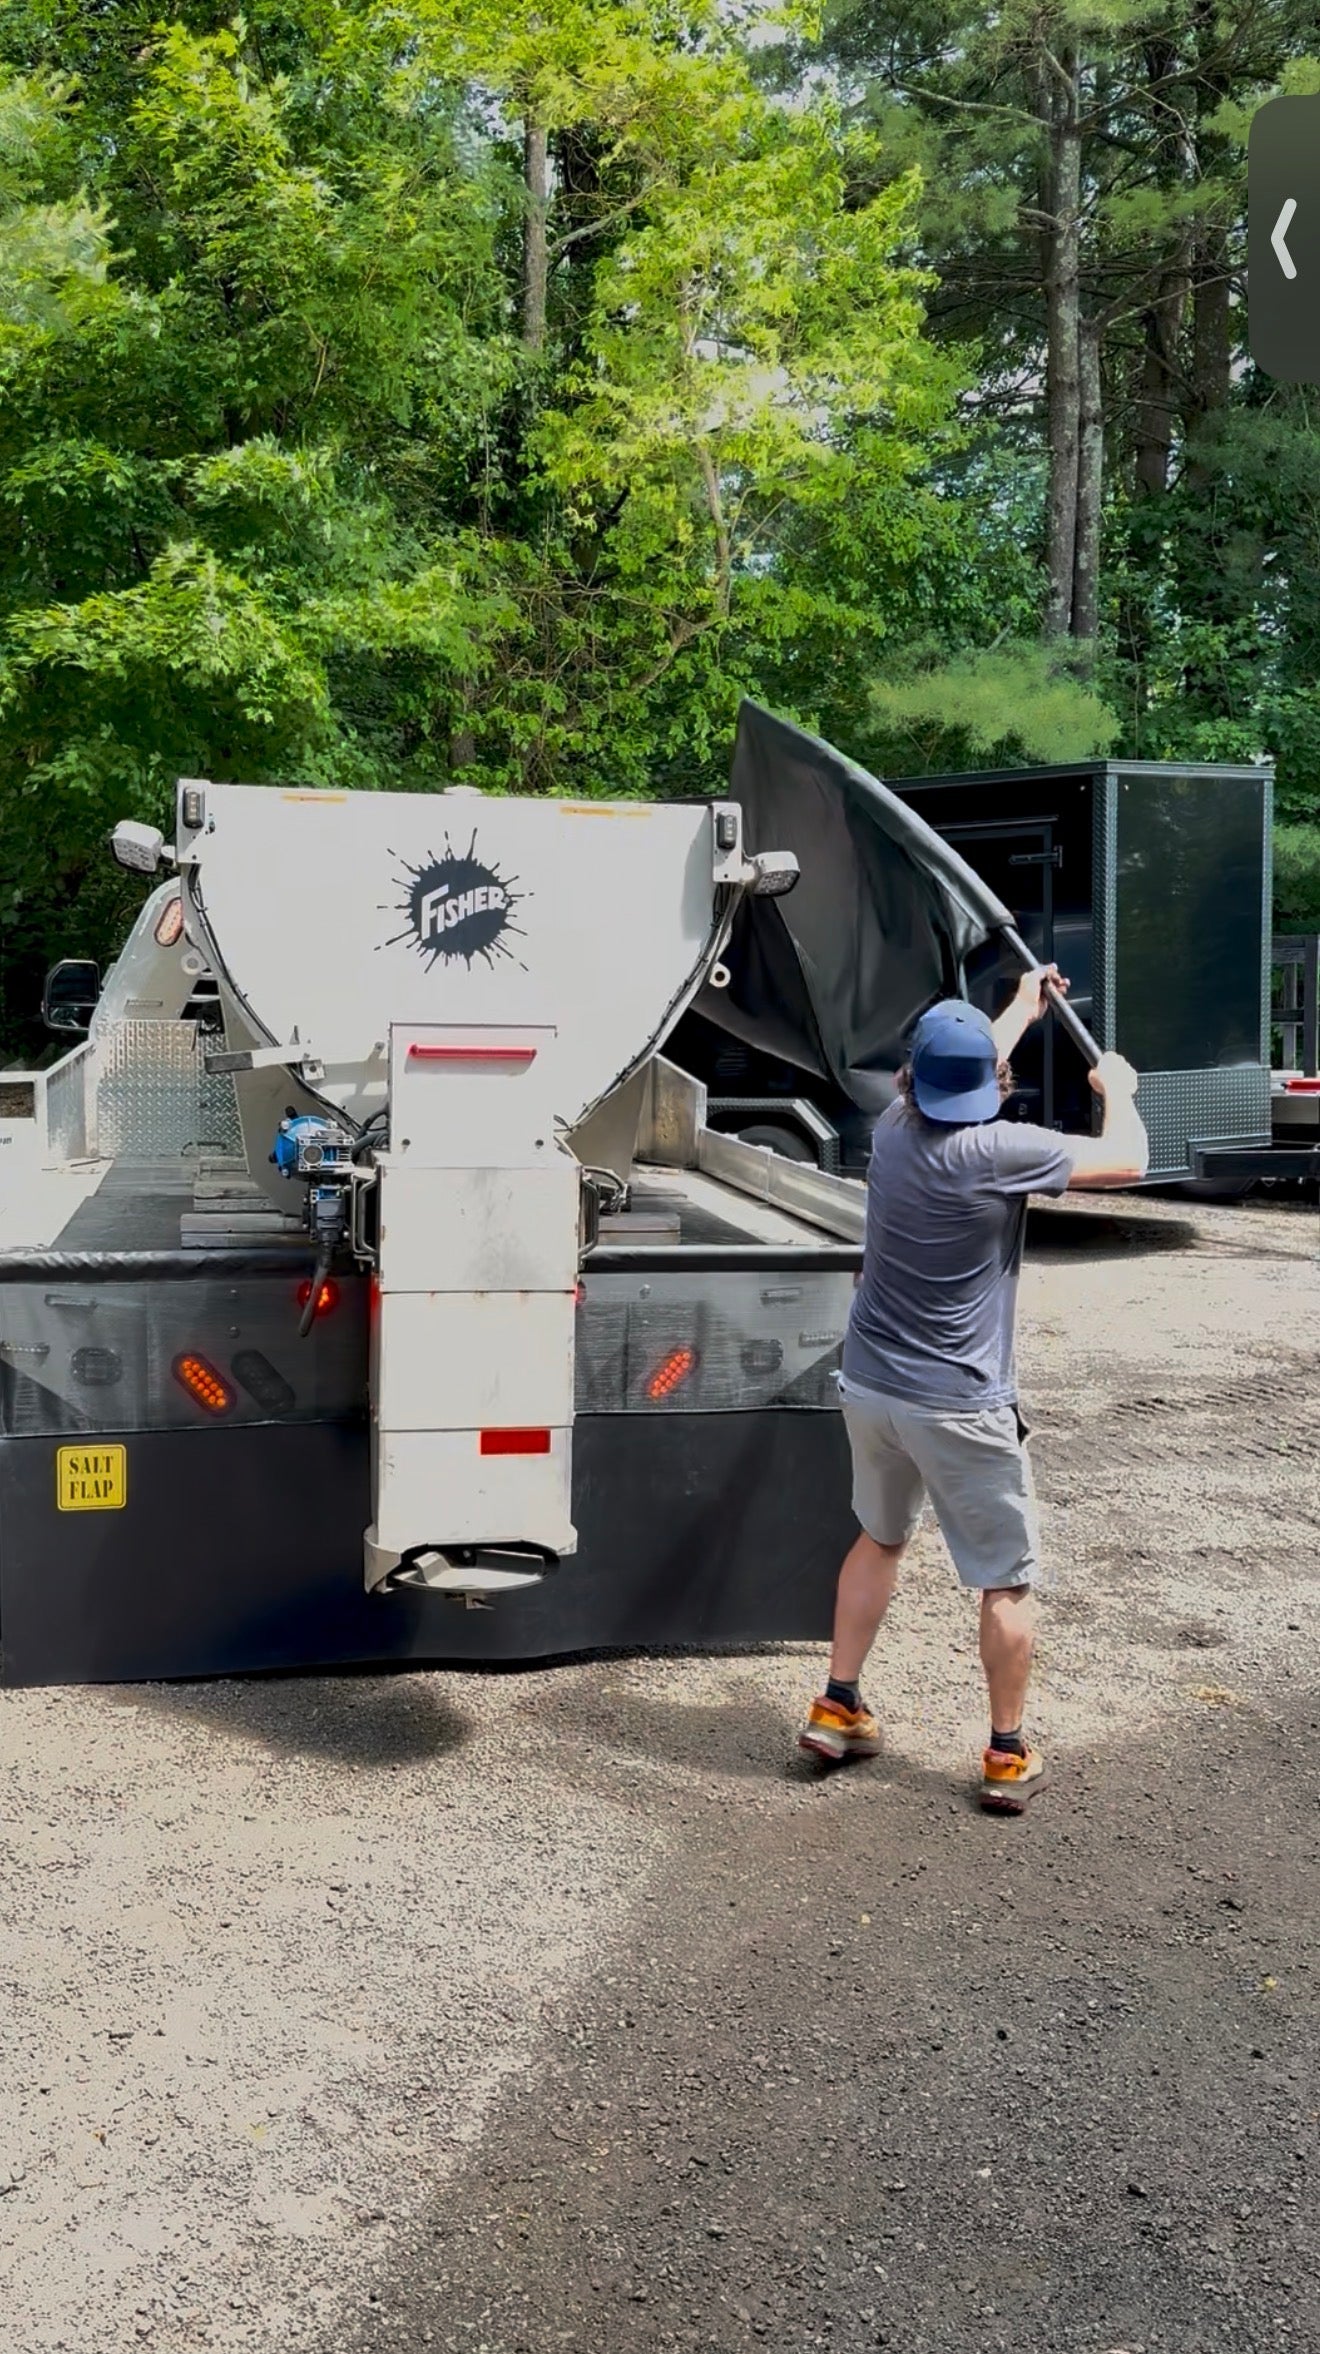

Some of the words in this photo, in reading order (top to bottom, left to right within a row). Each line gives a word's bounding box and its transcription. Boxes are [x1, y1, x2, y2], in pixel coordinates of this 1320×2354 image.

[421, 884, 507, 941] FISHER
[69, 1455, 114, 1475] SALT
[69, 1480, 114, 1500] FLAP
